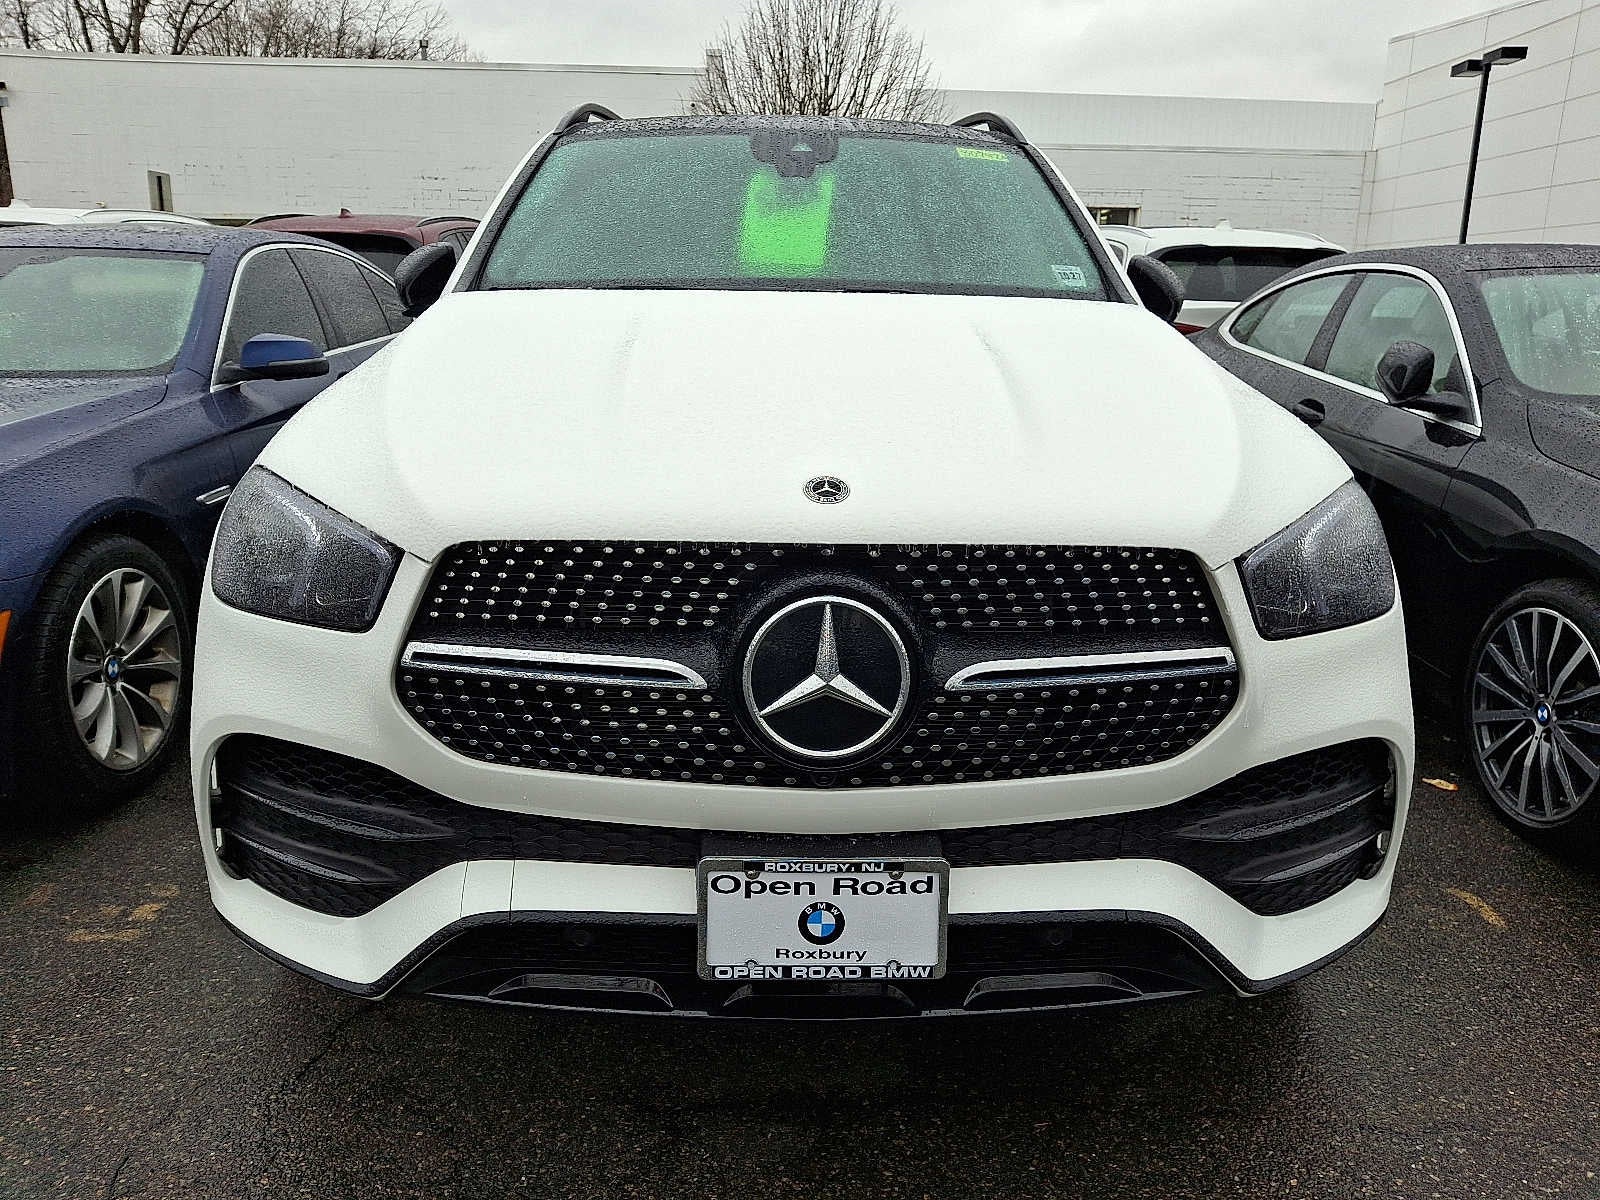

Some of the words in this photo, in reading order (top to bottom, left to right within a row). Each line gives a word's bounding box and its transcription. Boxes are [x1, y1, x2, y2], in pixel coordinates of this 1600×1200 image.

[861, 863, 885, 872] NJ
[710, 874, 816, 899] Open
[832, 875, 934, 896] Road
[804, 902, 841, 916] BMW
[775, 947, 867, 961] Roxbury
[714, 966, 783, 979] OPEN
[791, 966, 861, 979] ROAD
[870, 966, 931, 979] BMW
